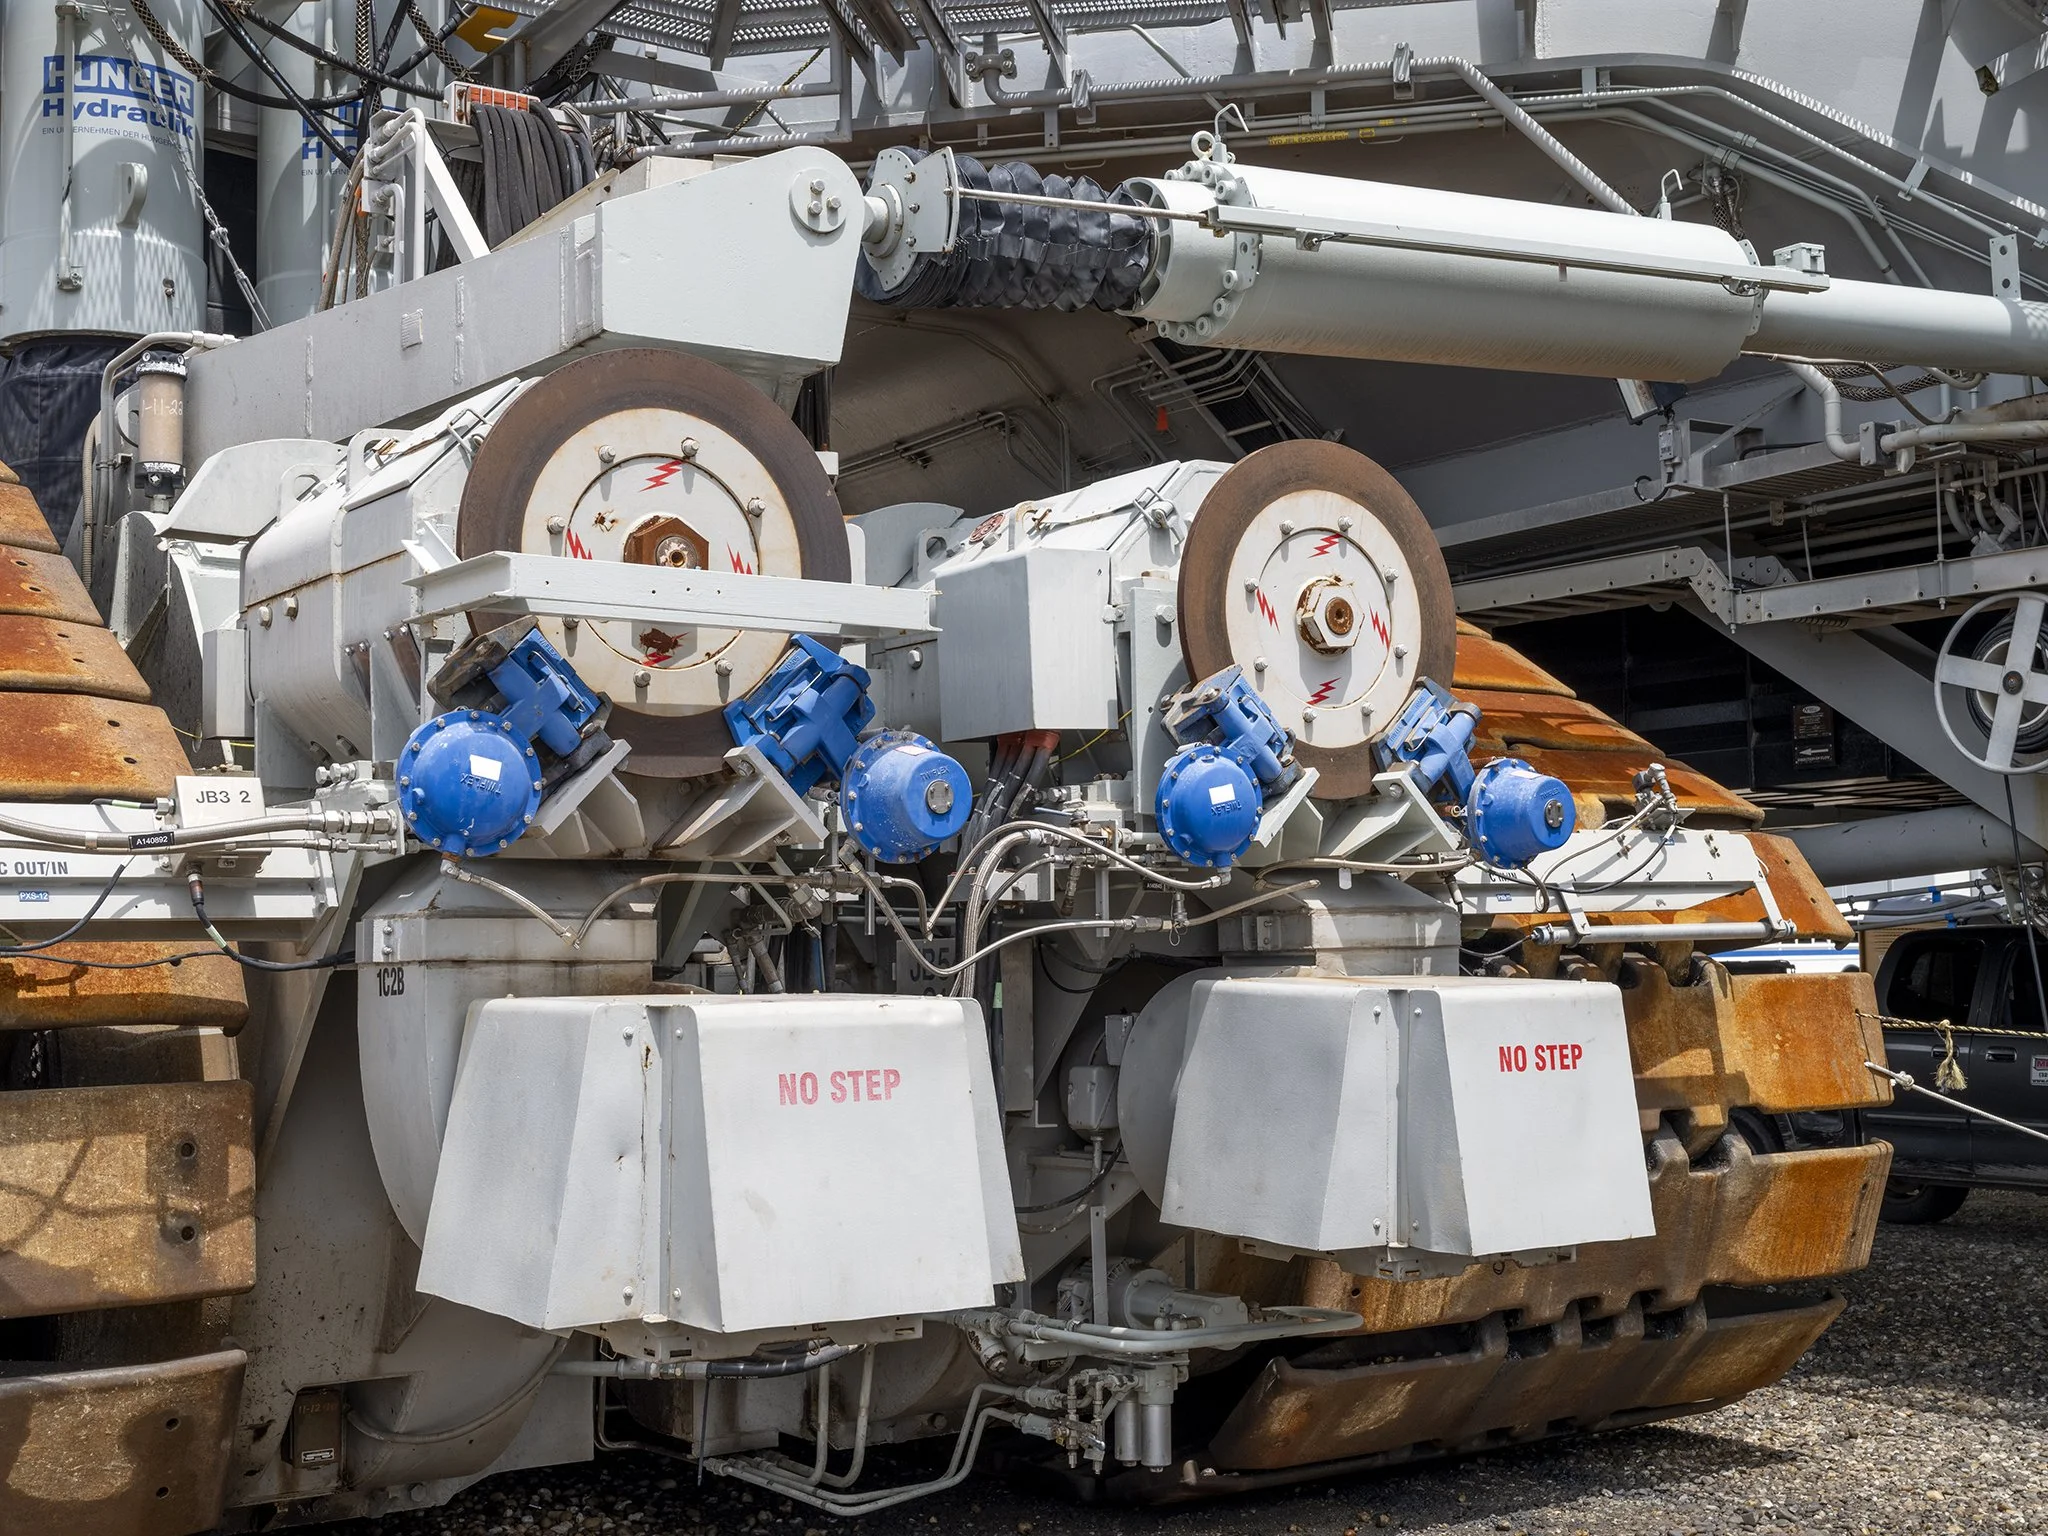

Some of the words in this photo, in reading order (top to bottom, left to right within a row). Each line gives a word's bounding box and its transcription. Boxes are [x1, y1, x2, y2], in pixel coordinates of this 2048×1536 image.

[123, 130, 139, 138] DER
[196, 790, 230, 804] JB3
[239, 790, 252, 803] 2
[136, 835, 169, 846] A140892
[14, 860, 69, 876] OUT/IN
[1706, 871, 1714, 881] 3
[19, 891, 48, 901] PXS-12
[377, 966, 405, 997] 1C2B
[1498, 1045, 1528, 1072] NO
[1534, 1043, 1583, 1071] STEP
[778, 1071, 819, 1106] NO
[829, 1068, 901, 1104] STEP
